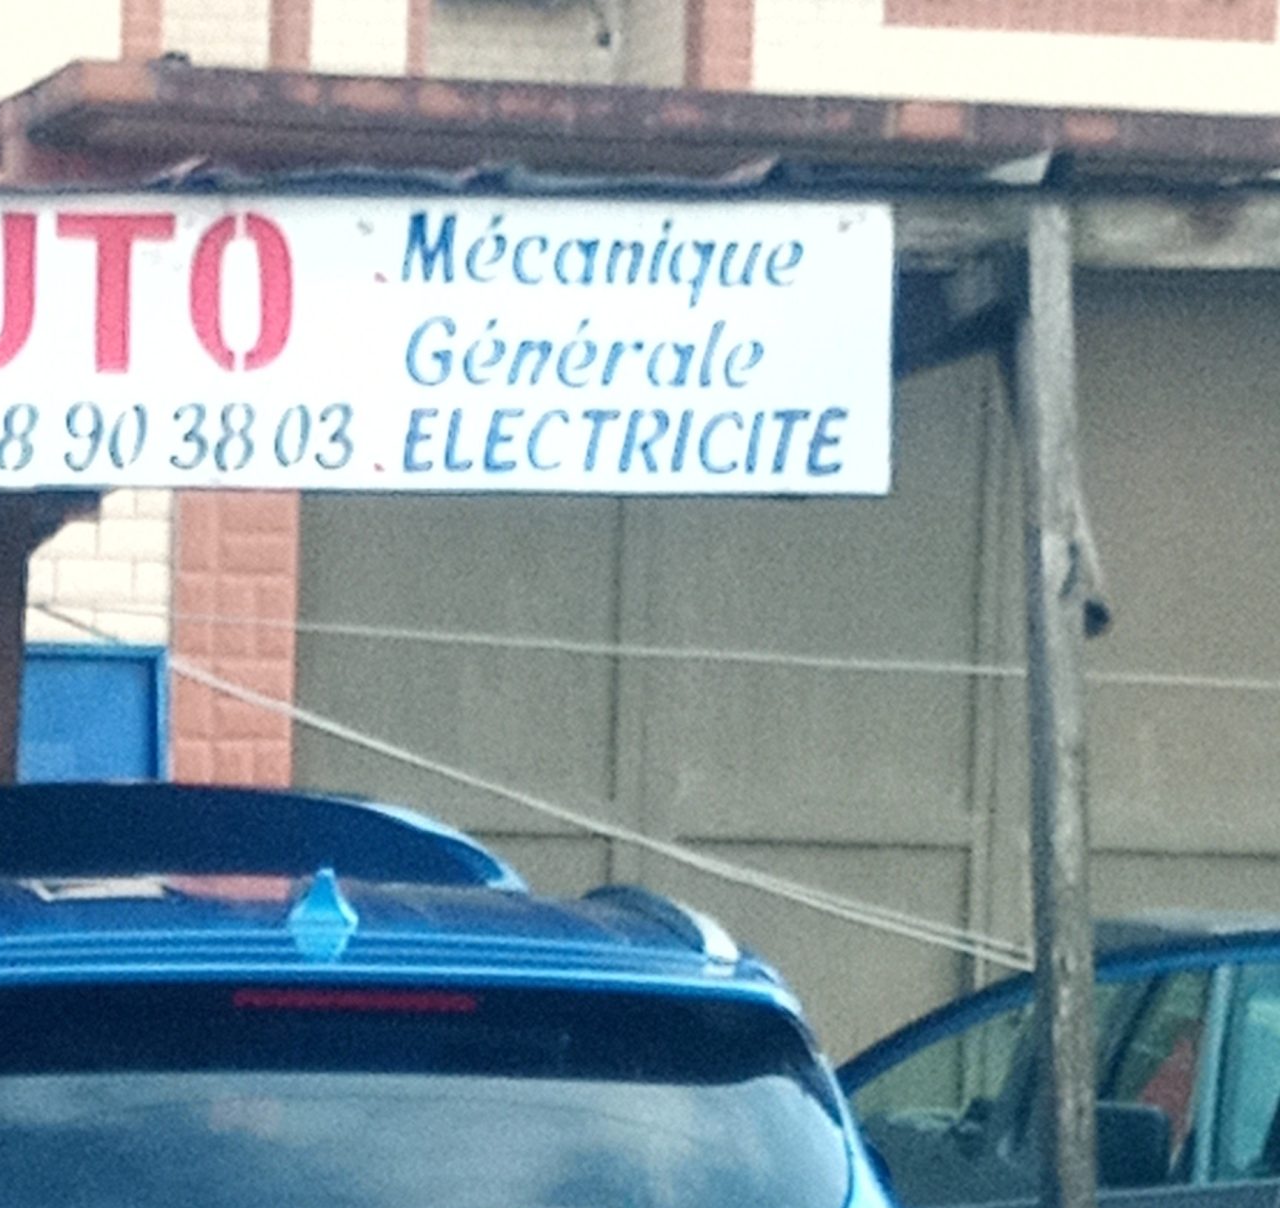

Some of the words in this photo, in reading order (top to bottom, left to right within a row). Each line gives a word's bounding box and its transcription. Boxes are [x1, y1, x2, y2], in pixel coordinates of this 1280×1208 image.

[401, 210, 805, 308] Mécanique
[404, 316, 766, 388] Générale
[64, 402, 148, 472] 90
[170, 402, 256, 472] 38
[274, 403, 354, 471] 03
[401, 406, 850, 476] ELECTRICITE
